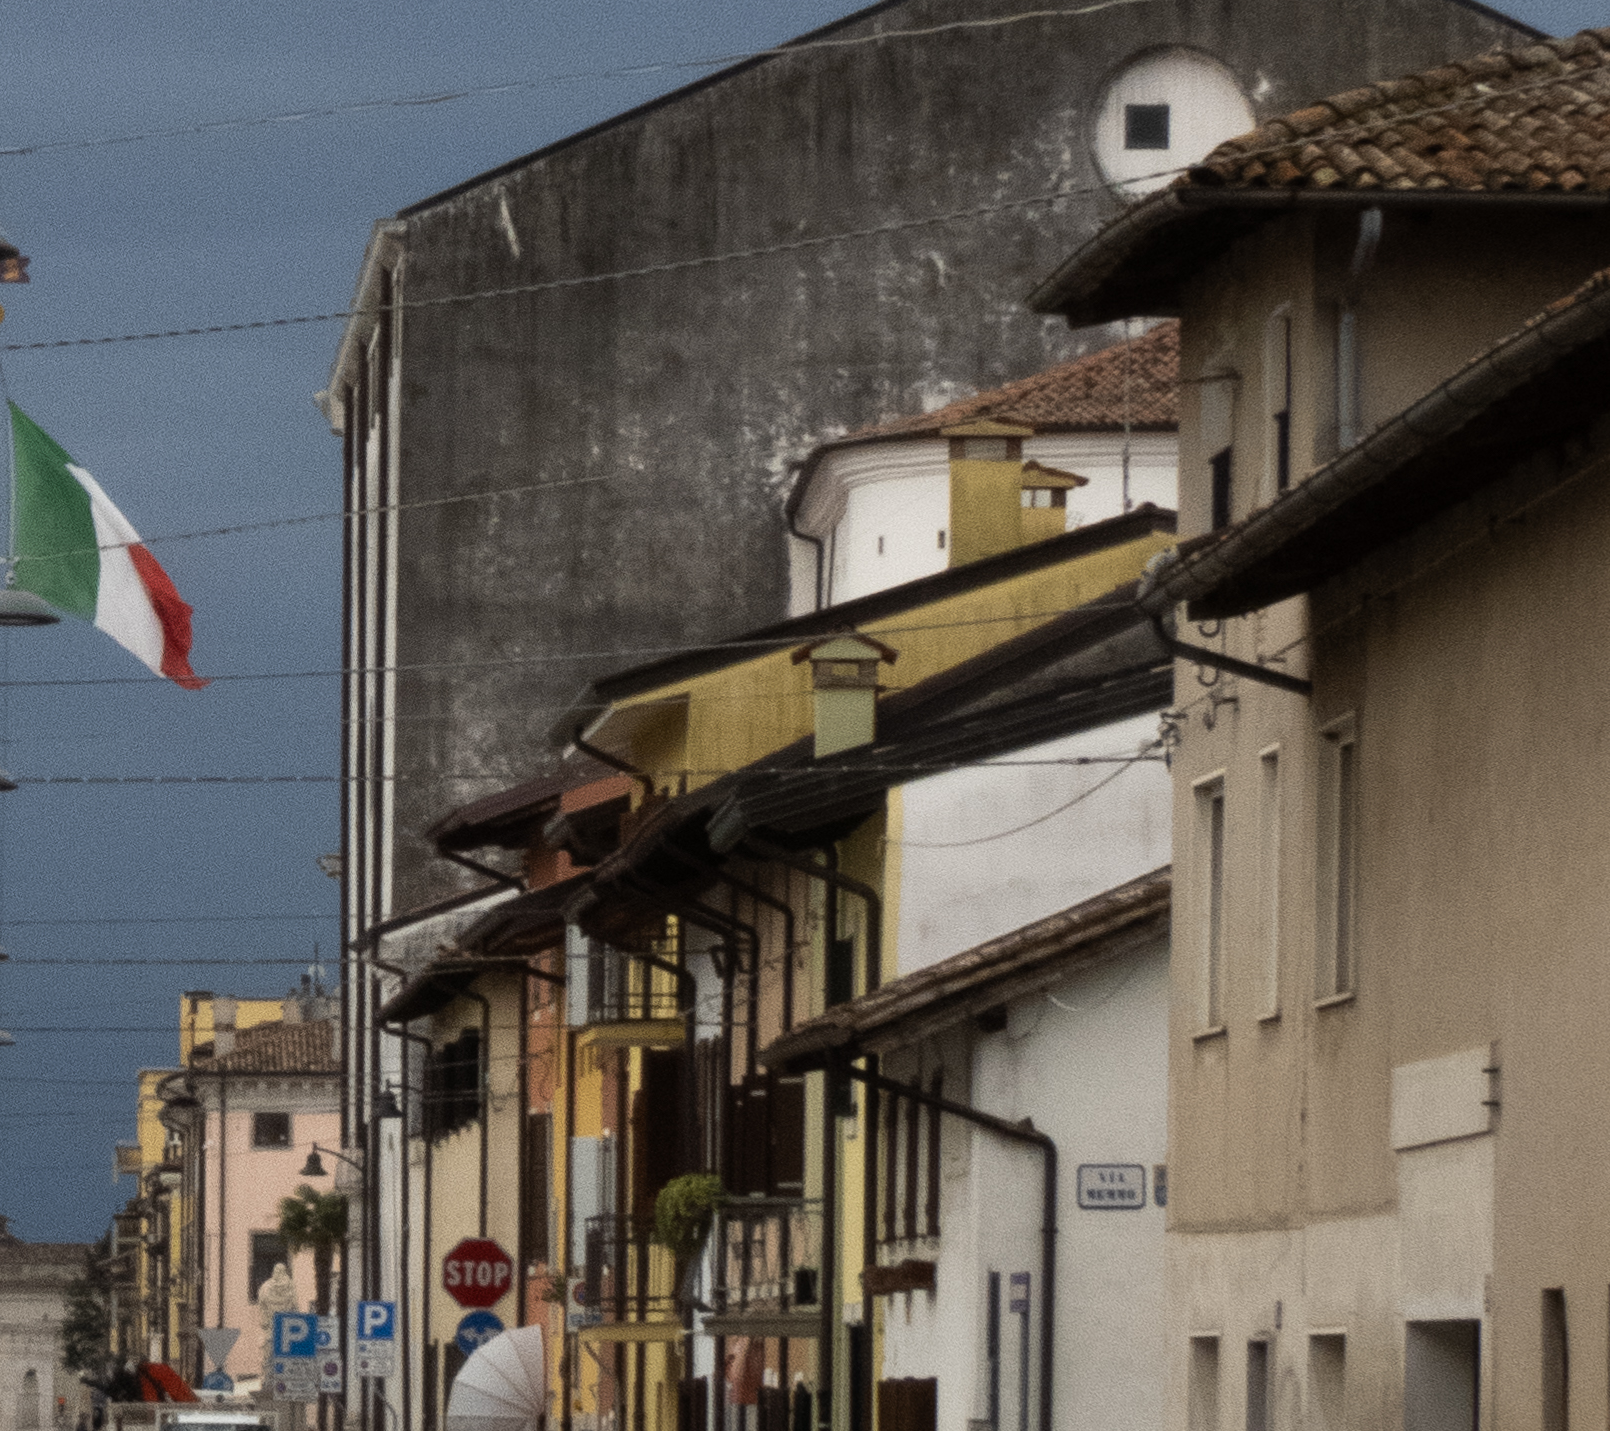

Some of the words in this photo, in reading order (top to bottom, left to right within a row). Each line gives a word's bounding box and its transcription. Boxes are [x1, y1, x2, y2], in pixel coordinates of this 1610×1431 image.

[447, 1260, 509, 1287] STOP
[282, 1318, 309, 1353] P
[364, 1306, 388, 1336] P
